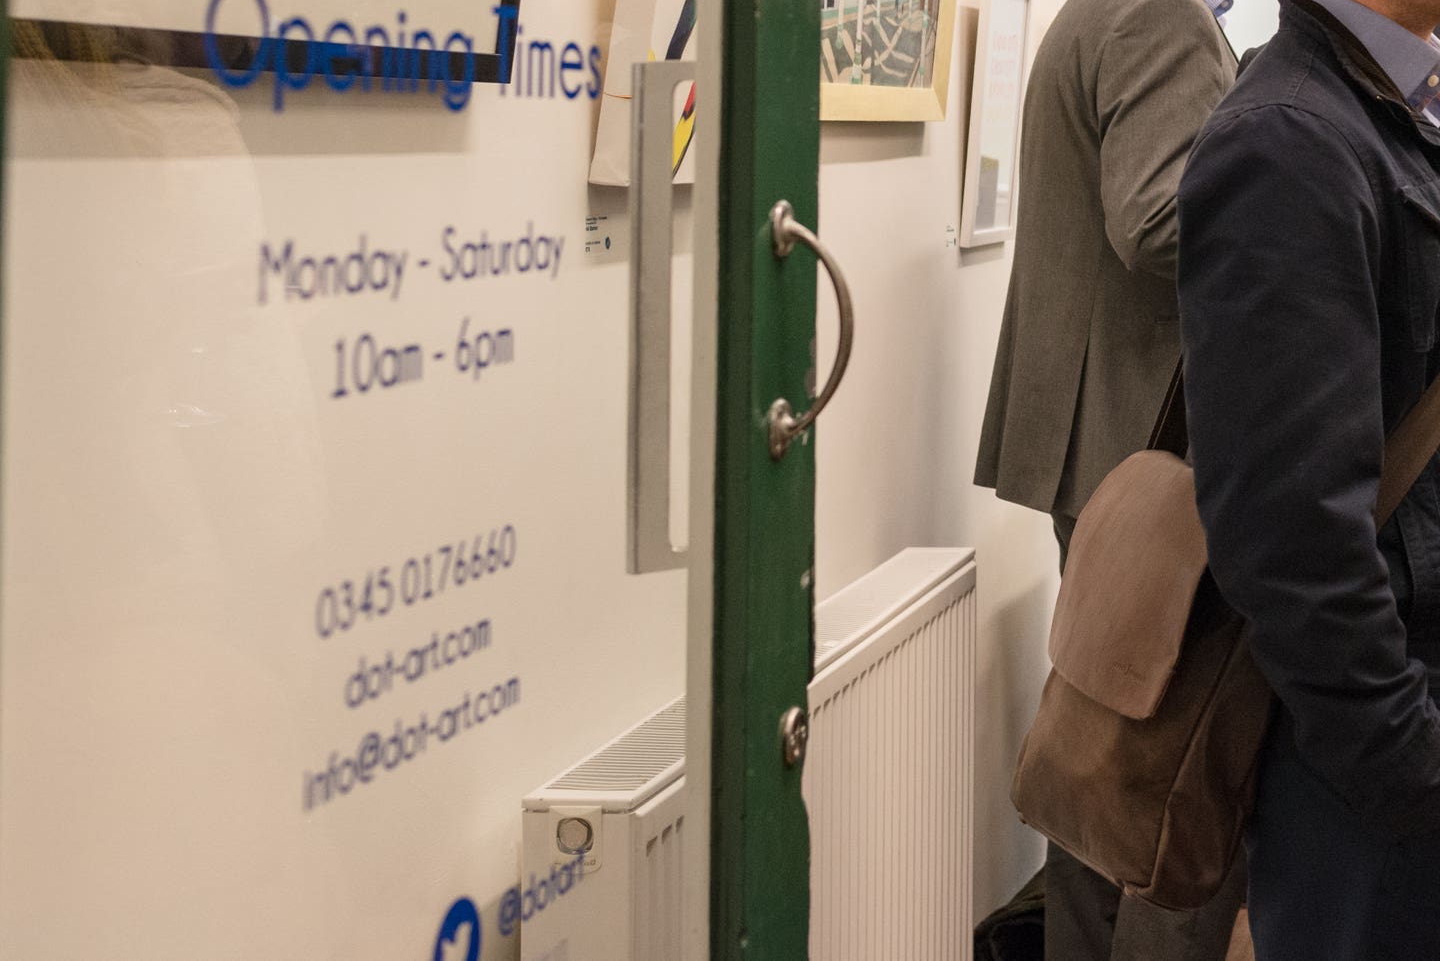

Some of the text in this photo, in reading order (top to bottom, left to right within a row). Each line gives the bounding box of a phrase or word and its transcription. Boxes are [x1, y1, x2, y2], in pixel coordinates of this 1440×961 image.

[493, 5, 603, 101] Times
[256, 233, 408, 307] Monday
[439, 221, 566, 283] Saturday
[330, 332, 424, 399] 10am
[455, 317, 516, 382] 6pm
[316, 524, 518, 639] 0345 0176660
[344, 617, 493, 710] dot-art.com
[302, 676, 520, 811] info@dot-art.com
[497, 848, 587, 938] @dotart
